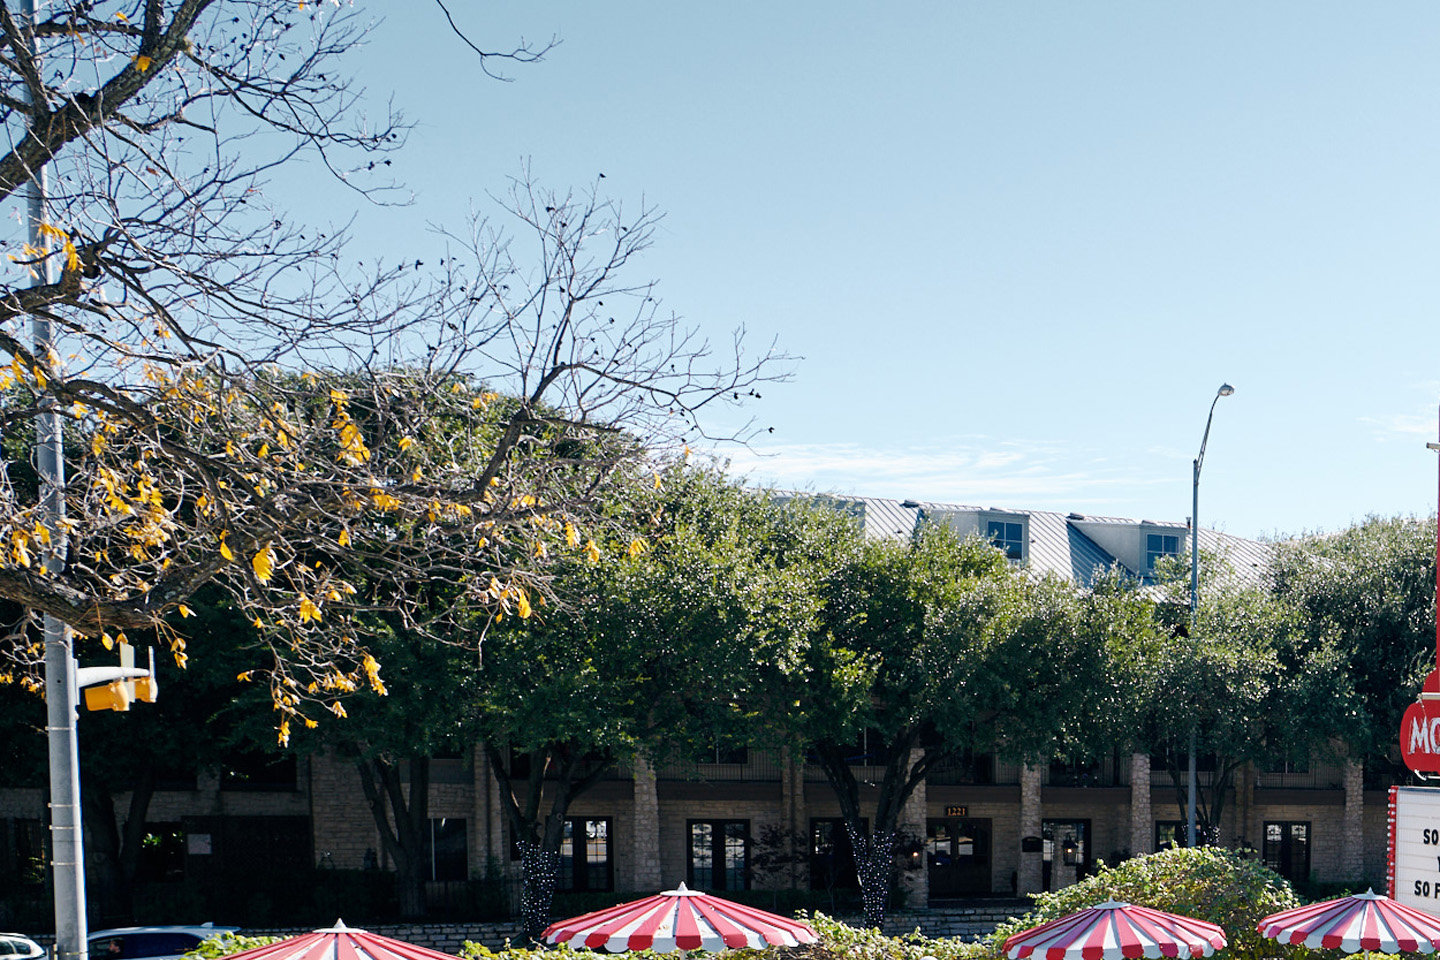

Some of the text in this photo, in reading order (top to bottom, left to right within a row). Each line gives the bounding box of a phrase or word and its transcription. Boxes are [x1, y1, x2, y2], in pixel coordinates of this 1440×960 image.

[947, 807, 966, 816] 1221
[1423, 829, 1439, 846] SO
[1414, 880, 1430, 897] SO
